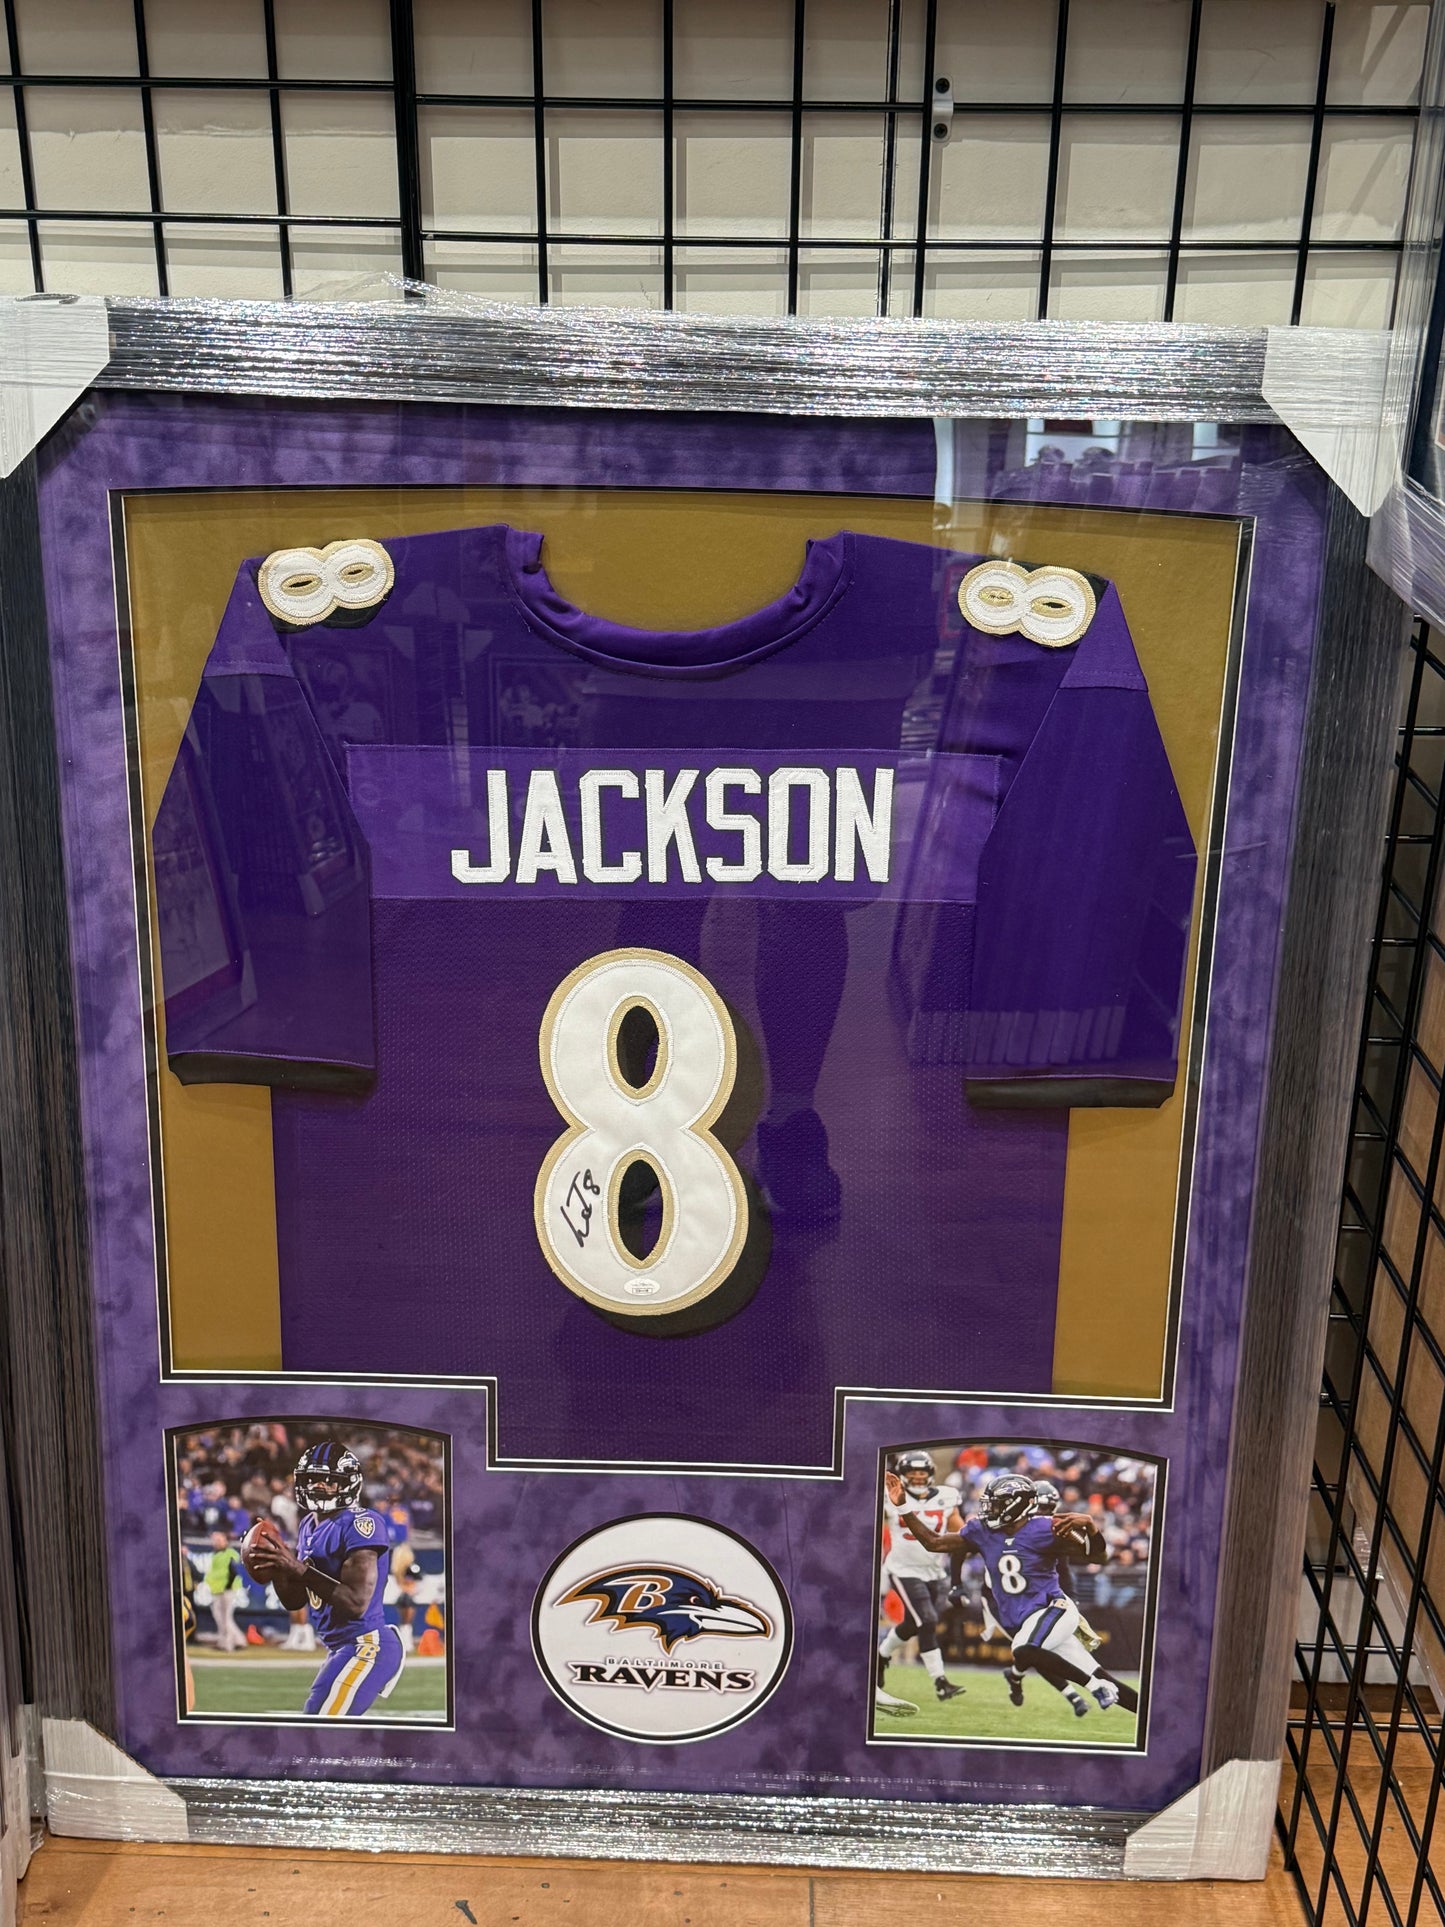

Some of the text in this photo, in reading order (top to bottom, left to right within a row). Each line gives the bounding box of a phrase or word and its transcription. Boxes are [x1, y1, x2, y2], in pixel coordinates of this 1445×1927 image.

[451, 767, 894, 884] JACKSON
[534, 947, 748, 1316] 8
[603, 1575, 674, 1613] B
[998, 1554, 1027, 1595] 8
[570, 1664, 755, 1691] RAVENS
[608, 1658, 722, 1670] BALTIMORE
